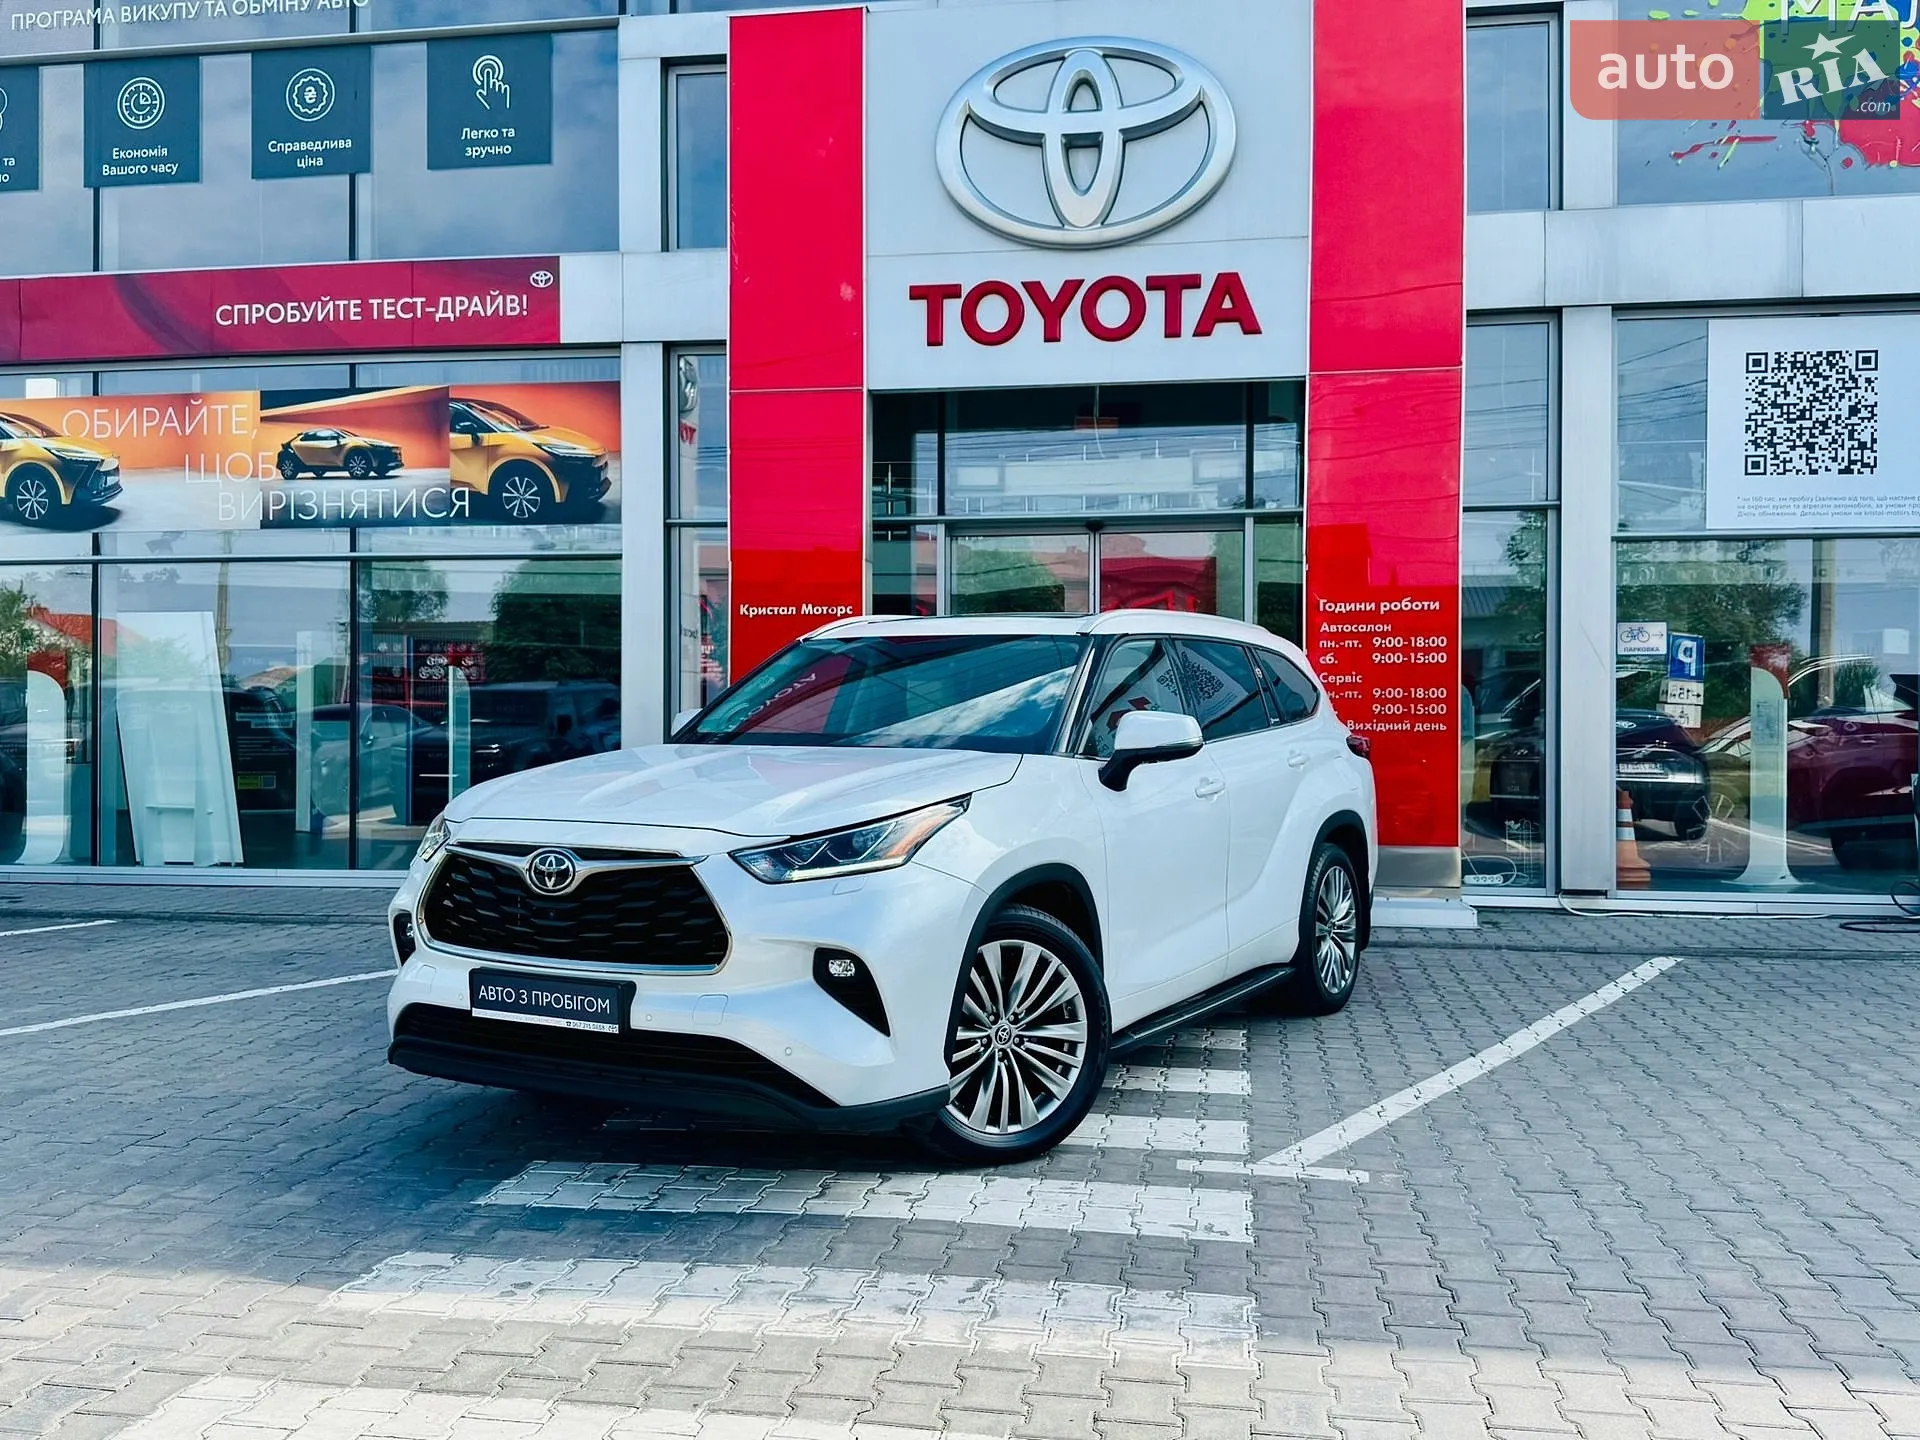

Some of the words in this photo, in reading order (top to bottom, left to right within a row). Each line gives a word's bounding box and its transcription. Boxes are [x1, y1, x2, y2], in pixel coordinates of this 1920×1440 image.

[11, 7, 116, 31] ПРОГРАМА
[120, 1, 201, 24] ВИКУПУ
[204, 0, 228, 17] ТА
[461, 127, 499, 140] Легко
[501, 127, 516, 138] та
[112, 144, 168, 160] Економія
[268, 138, 352, 155] Справедлива
[464, 144, 512, 159] зручно
[3, 157, 16, 167] та
[296, 154, 324, 168] ціна
[102, 164, 148, 176] Вашого
[151, 162, 179, 175] часу
[215, 296, 362, 326] СПРОБУЙТЕ
[369, 290, 529, 322] ТЕСТ-ДРАЙВ!
[908, 271, 1263, 347] TOYOTA
[62, 399, 259, 440] ОБИРАЙТЕ,
[184, 451, 277, 488] ЩОБ
[217, 486, 471, 523] ВИРІЗНЯТИСЯ
[739, 603, 797, 618] Кристал
[800, 603, 854, 617] Моторс
[1319, 599, 1376, 614] Години
[1379, 597, 1441, 615] роботи
[1319, 622, 1392, 633] Автосалон
[1319, 639, 1363, 648] пн.-пт.
[1372, 636, 1448, 648] 9:00-18:00
[1319, 652, 1339, 664] сб.
[1371, 652, 1448, 664] 9:00-15:00
[1319, 671, 1364, 685] Сервіс
[1327, 690, 1363, 699] н.-пт.
[1372, 687, 1448, 699] 9:00-18:00
[1371, 703, 1448, 715] 9:00-15:00
[1346, 719, 1412, 733] Вихідний
[1413, 721, 1448, 733] день
[478, 985, 515, 1003] АВТО
[519, 989, 528, 1004] З
[531, 990, 610, 1014] ПРОБІГОМ
